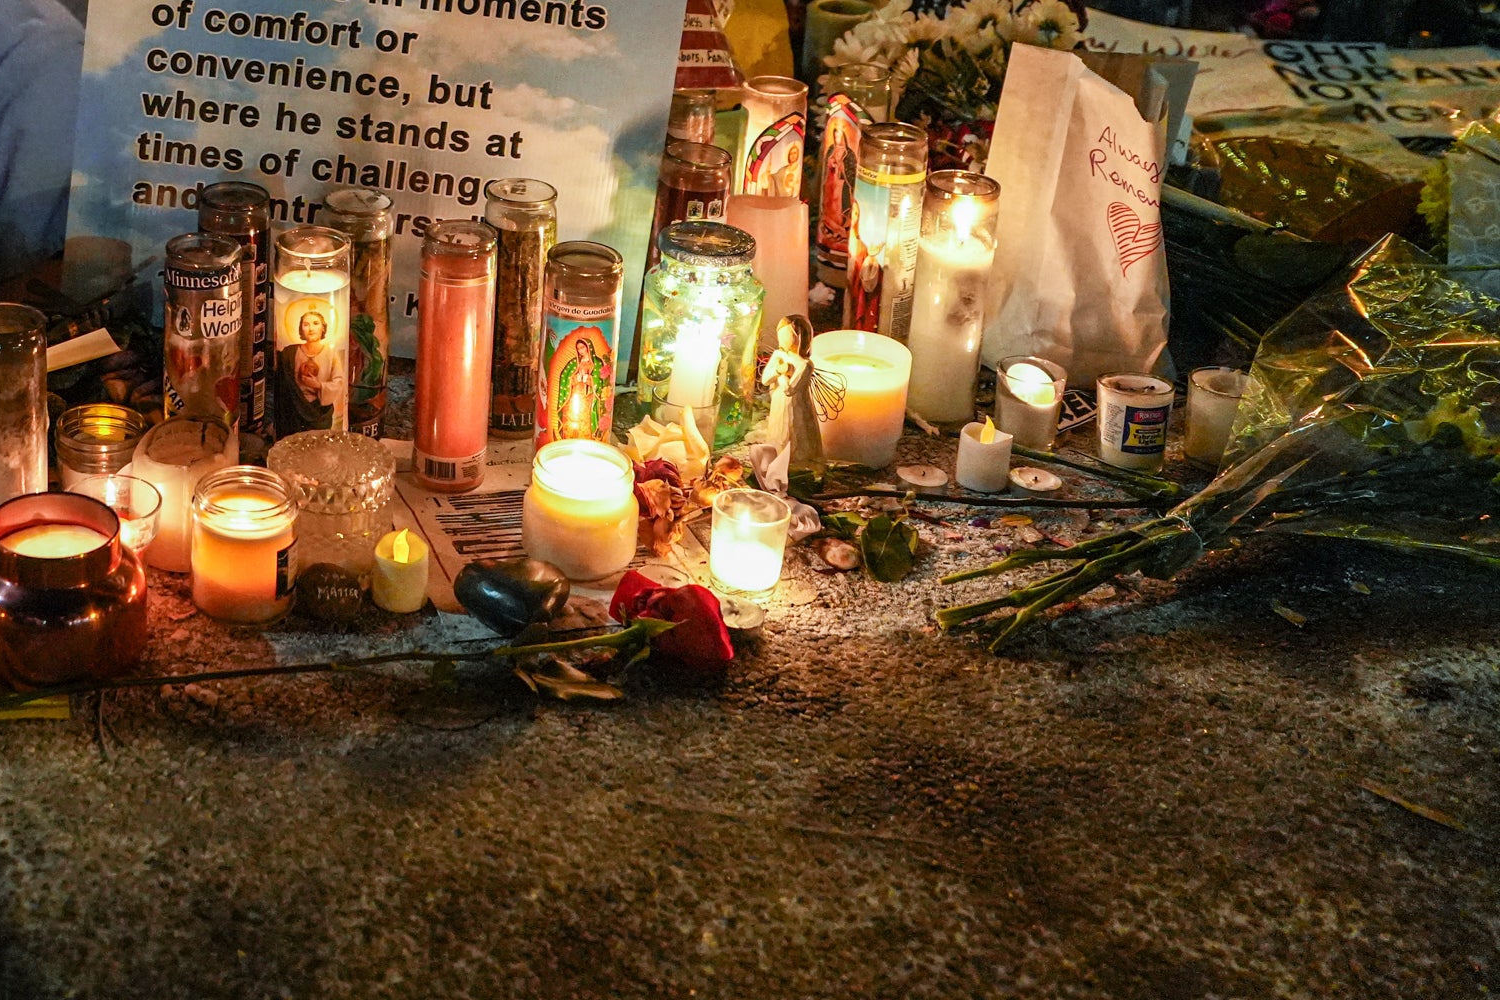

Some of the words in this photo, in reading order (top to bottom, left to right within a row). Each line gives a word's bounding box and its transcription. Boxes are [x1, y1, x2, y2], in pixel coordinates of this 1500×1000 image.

[151, 0, 194, 29] of
[204, 9, 362, 49] comfort
[375, 29, 419, 54] or
[147, 49, 411, 106] convenience,
[427, 74, 494, 110] but
[1262, 43, 1378, 66] GHT
[1273, 63, 1500, 83] NORAN
[142, 90, 260, 128] where
[275, 102, 321, 135] he
[336, 113, 470, 152] stands
[485, 130, 523, 159] at
[137, 132, 244, 172] times
[259, 148, 301, 177] of
[312, 154, 496, 206] challeng
[1098, 126, 1164, 183] Alway
[132, 181, 204, 210] and
[521, 411, 533, 426] LU
